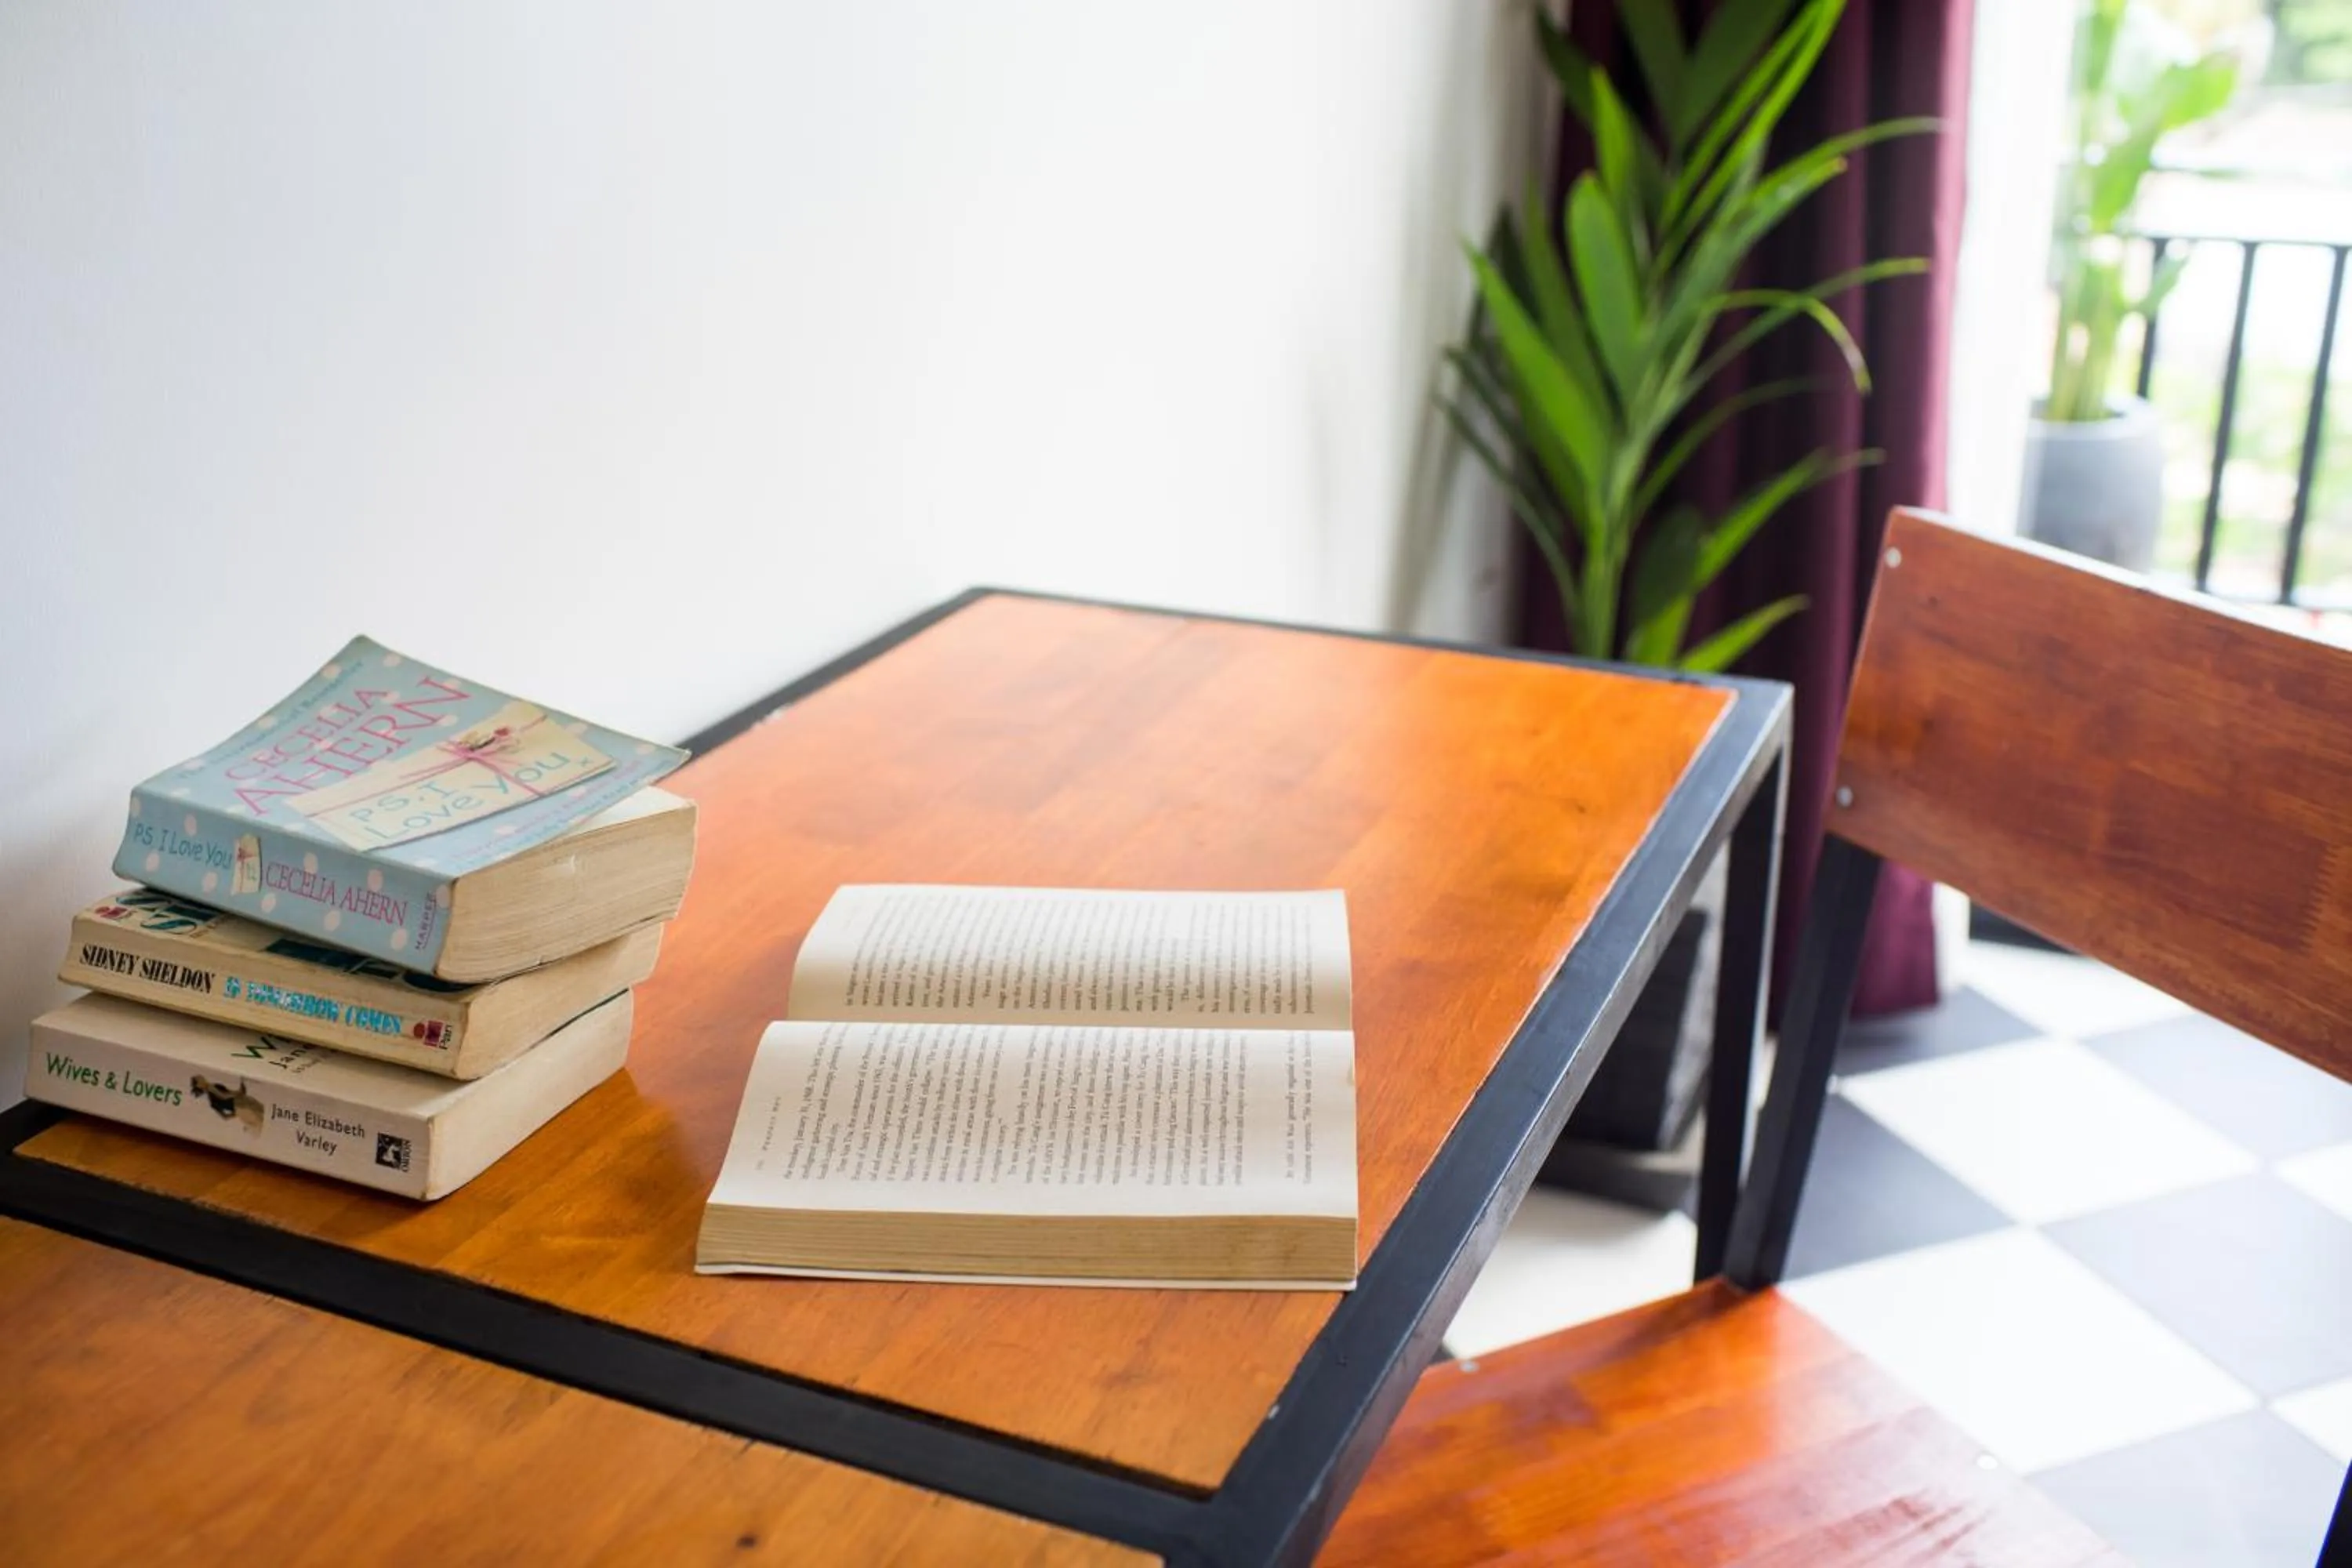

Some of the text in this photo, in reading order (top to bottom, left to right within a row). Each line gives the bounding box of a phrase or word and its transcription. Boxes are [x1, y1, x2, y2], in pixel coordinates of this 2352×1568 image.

[225, 688, 388, 781] CECELIA
[235, 676, 472, 818] AHERN
[363, 794, 485, 840] Love
[133, 823, 233, 870] PS I Love You
[266, 862, 408, 927] CECELIA AHERN
[79, 942, 216, 994] SIDNEY SHELDON
[46, 1051, 183, 1107] Wives & Lovers
[270, 1102, 365, 1138] Jane Elizabeth
[296, 1129, 338, 1157] Varley
